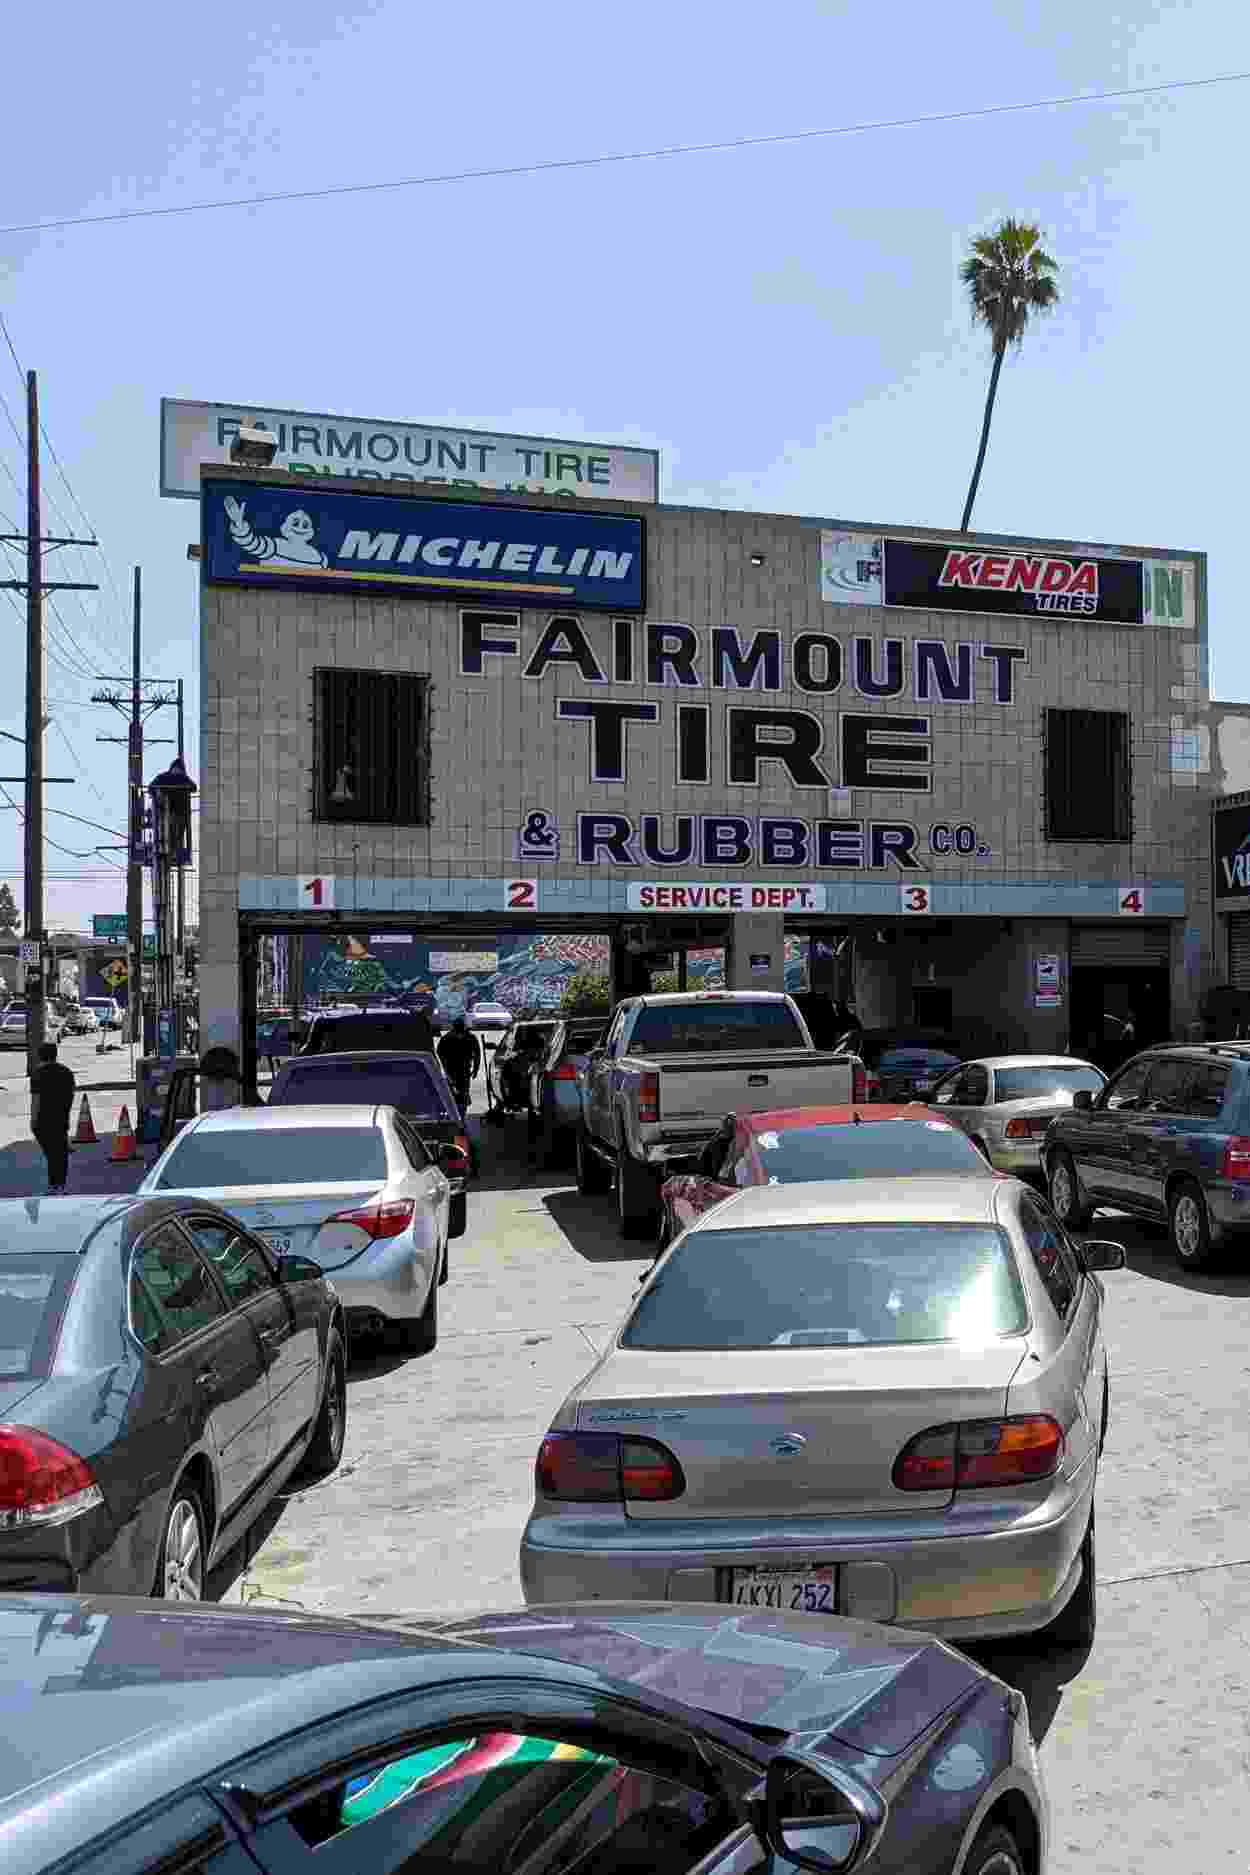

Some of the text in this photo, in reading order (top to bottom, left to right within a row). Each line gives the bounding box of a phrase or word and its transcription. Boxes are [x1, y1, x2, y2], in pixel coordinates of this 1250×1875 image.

[515, 448, 611, 484] TIRE
[336, 529, 634, 579] MICHELIN
[937, 550, 1099, 593] KENDA
[1034, 591, 1098, 614] TIRES
[459, 609, 1027, 704] FAIRMOUNT
[556, 698, 933, 793] TIRE
[519, 809, 558, 859] &
[576, 811, 930, 871] RUBBER
[305, 878, 323, 905] 1
[507, 881, 535, 908] 2
[639, 886, 815, 909] SERVICE DEPT.
[904, 886, 929, 911] 3
[1120, 889, 1143, 913] 4
